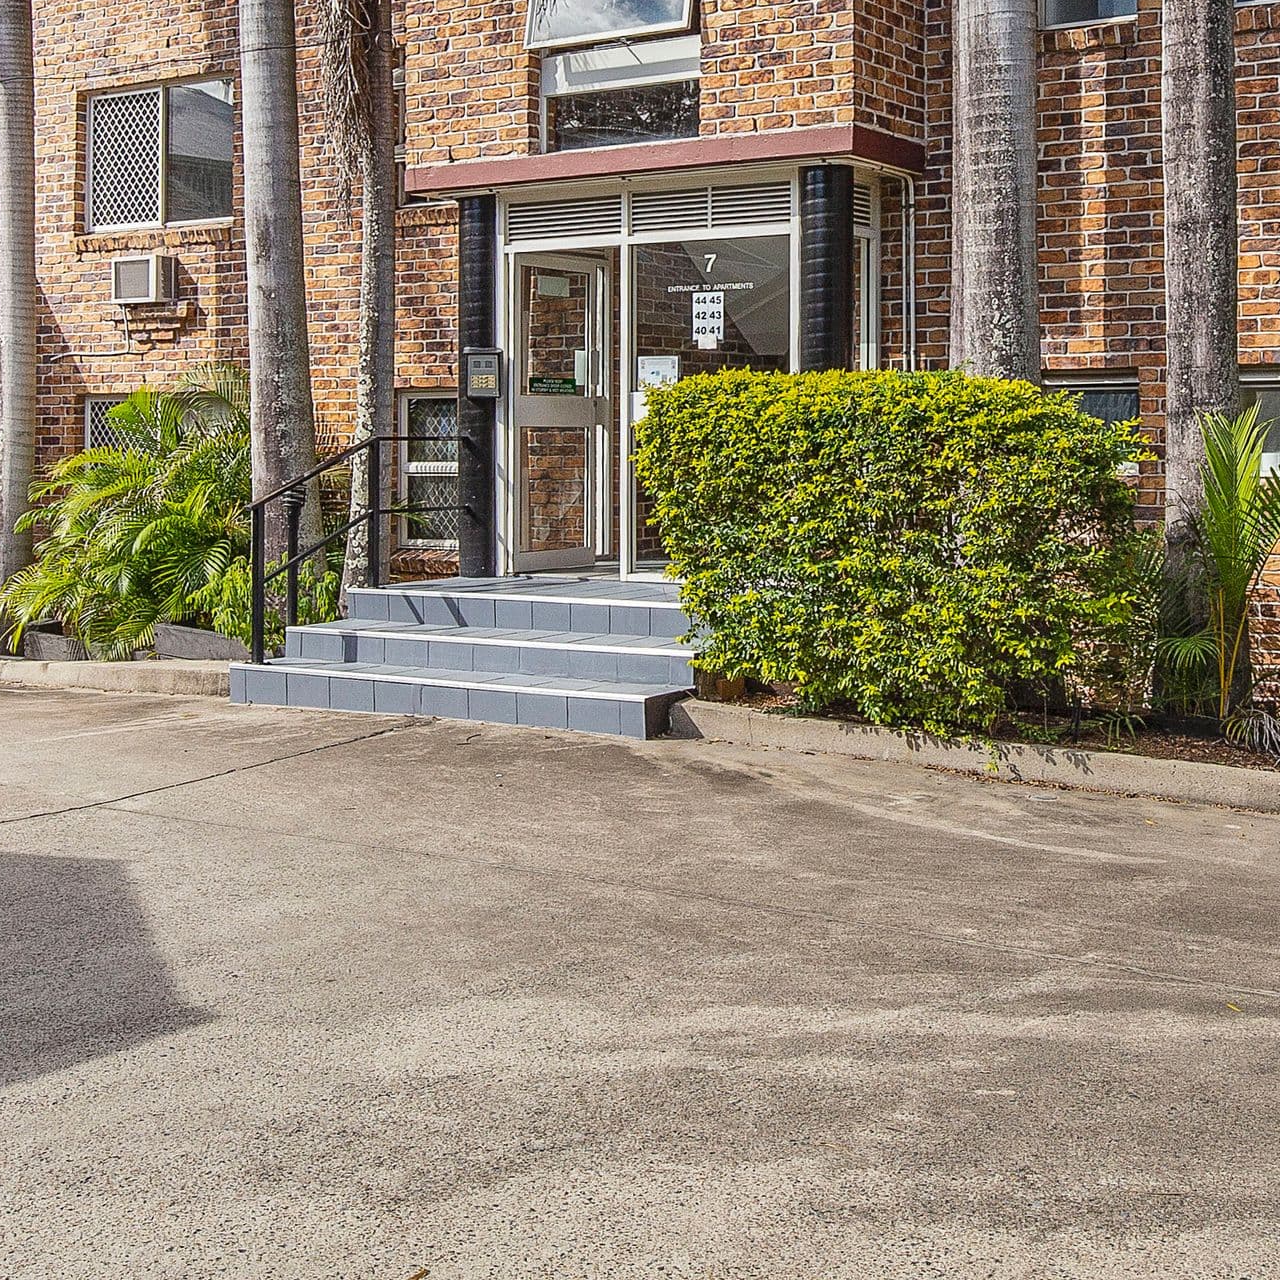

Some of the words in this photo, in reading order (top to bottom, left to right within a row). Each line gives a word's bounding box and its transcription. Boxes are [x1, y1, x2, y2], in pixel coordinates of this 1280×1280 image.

[704, 253, 717, 272] 7
[667, 284, 700, 293] ENTRANCE
[712, 282, 754, 290] APARTMENTS
[695, 296, 707, 304] 44
[709, 295, 722, 305] 45
[695, 311, 707, 320] 42
[709, 311, 722, 320] 43
[695, 326, 707, 335] 40
[709, 325, 721, 334] 41
